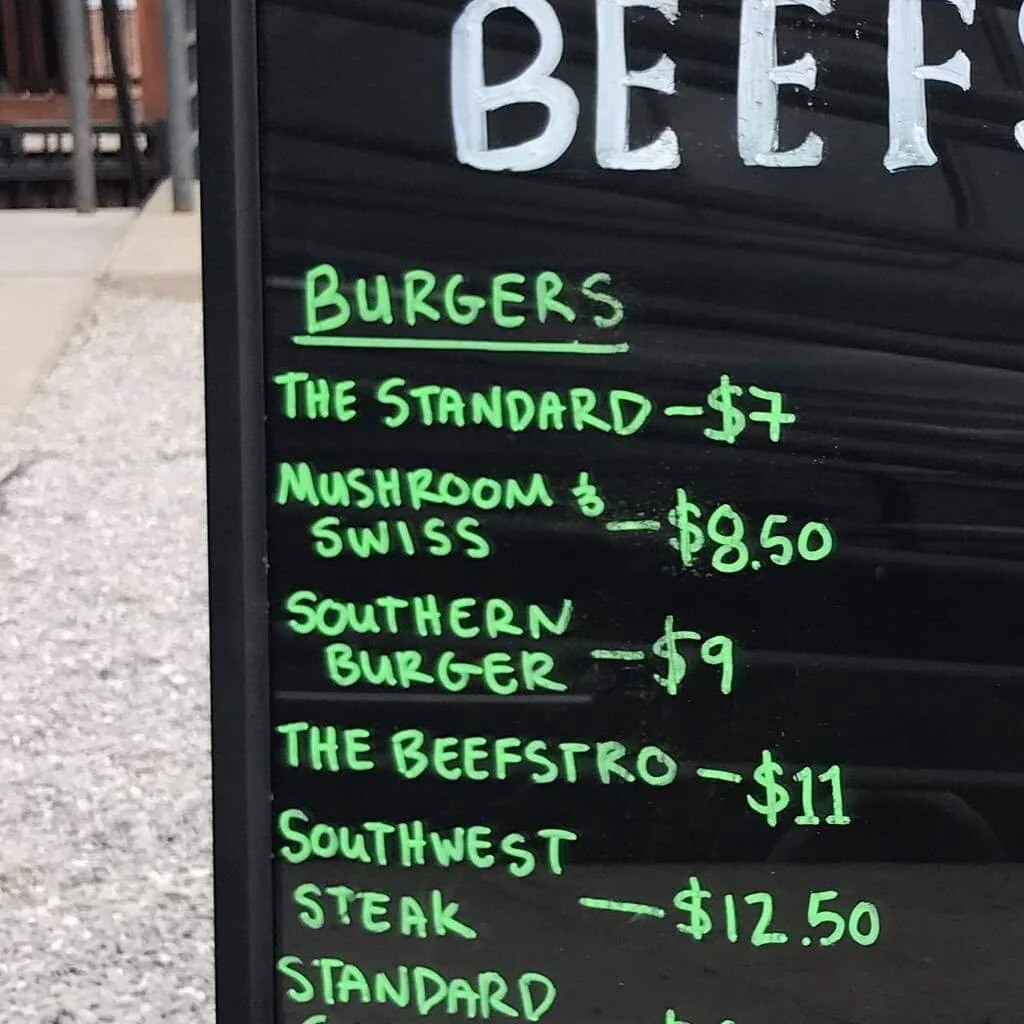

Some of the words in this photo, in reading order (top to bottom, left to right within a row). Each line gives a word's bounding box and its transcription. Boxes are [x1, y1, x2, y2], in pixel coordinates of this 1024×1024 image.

[303, 263, 626, 336] BURGERS
[273, 371, 358, 423] THE
[375, 377, 653, 436] STANDARD
[275, 462, 556, 511] MUSHROOM
[310, 515, 490, 560] SWISS
[284, 588, 574, 641] SOUTHERN
[324, 642, 568, 696] BURGER
[276, 721, 375, 773] THE
[390, 727, 678, 787] BEEFSTRO
[278, 808, 578, 875] SOUTHWEST
[292, 883, 479, 940] STEAK
[277, 955, 558, 1023] STANDARD
